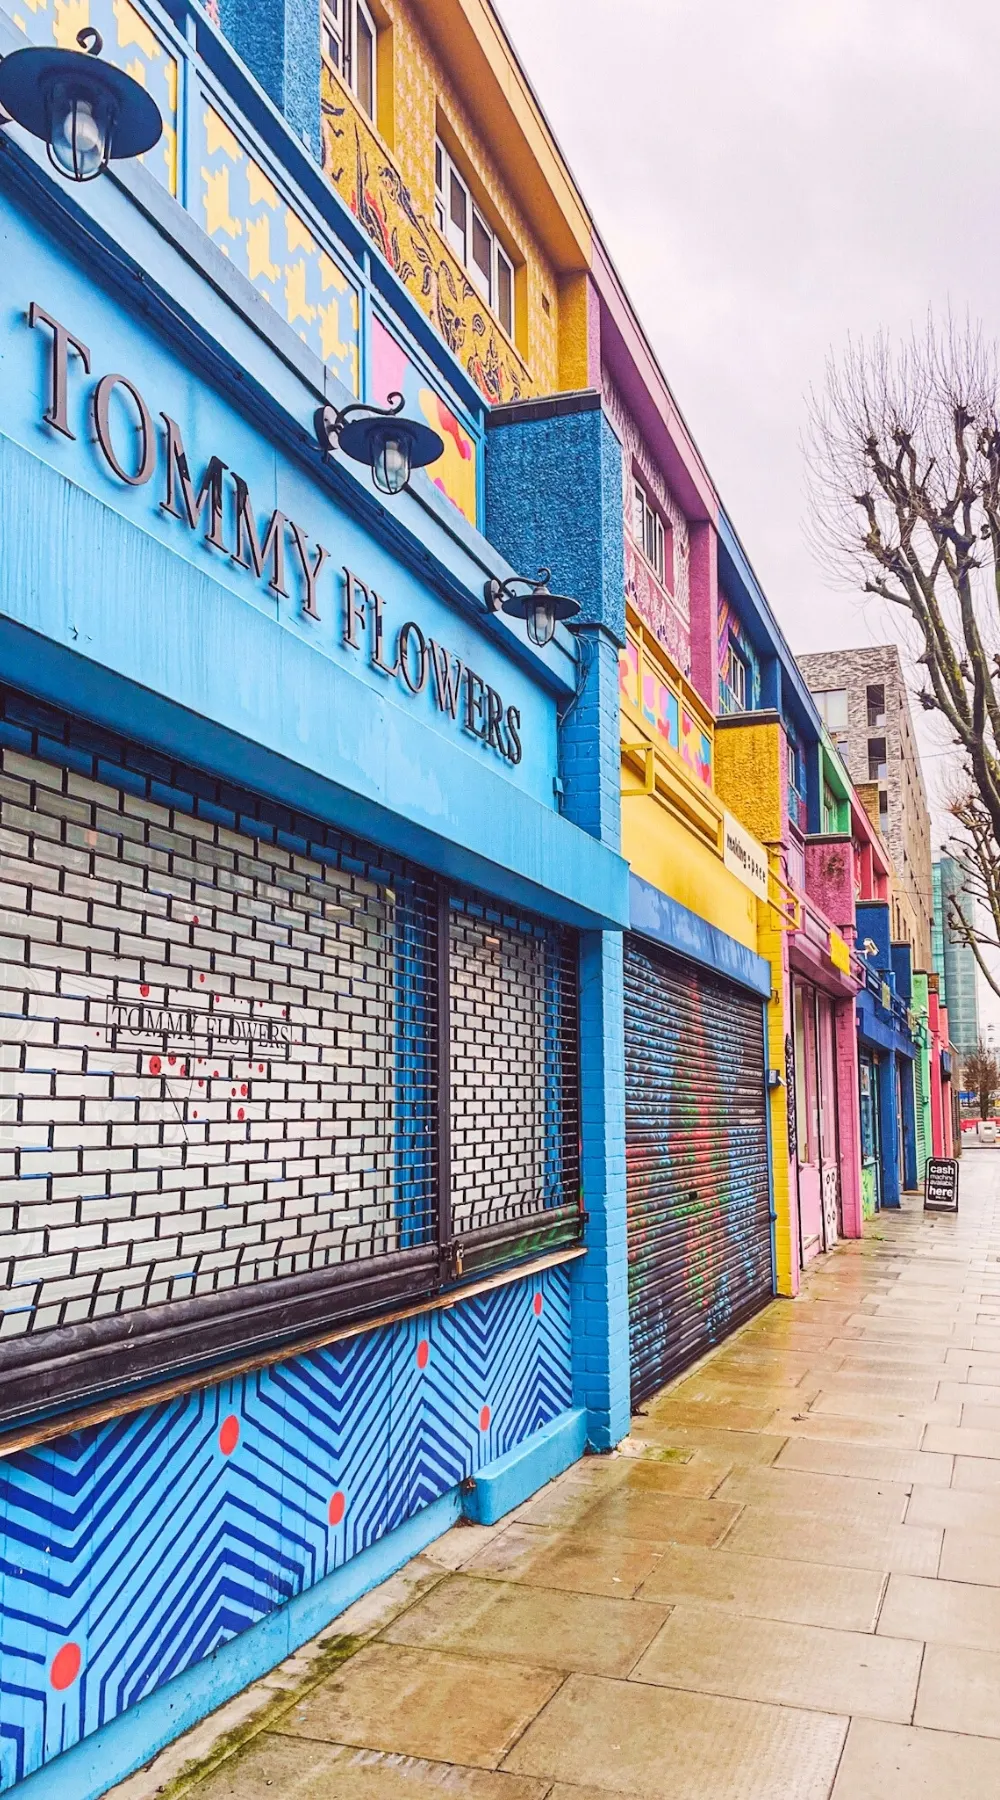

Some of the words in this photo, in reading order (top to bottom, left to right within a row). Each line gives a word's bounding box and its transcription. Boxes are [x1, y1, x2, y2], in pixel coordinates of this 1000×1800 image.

[28, 301, 330, 621] TOMMY
[341, 566, 523, 765] FLOWERS
[111, 1005, 198, 1040] TOMMY
[205, 1016, 289, 1050] FLOWERS
[930, 1165, 954, 1174] cash
[929, 1186, 953, 1197] here
